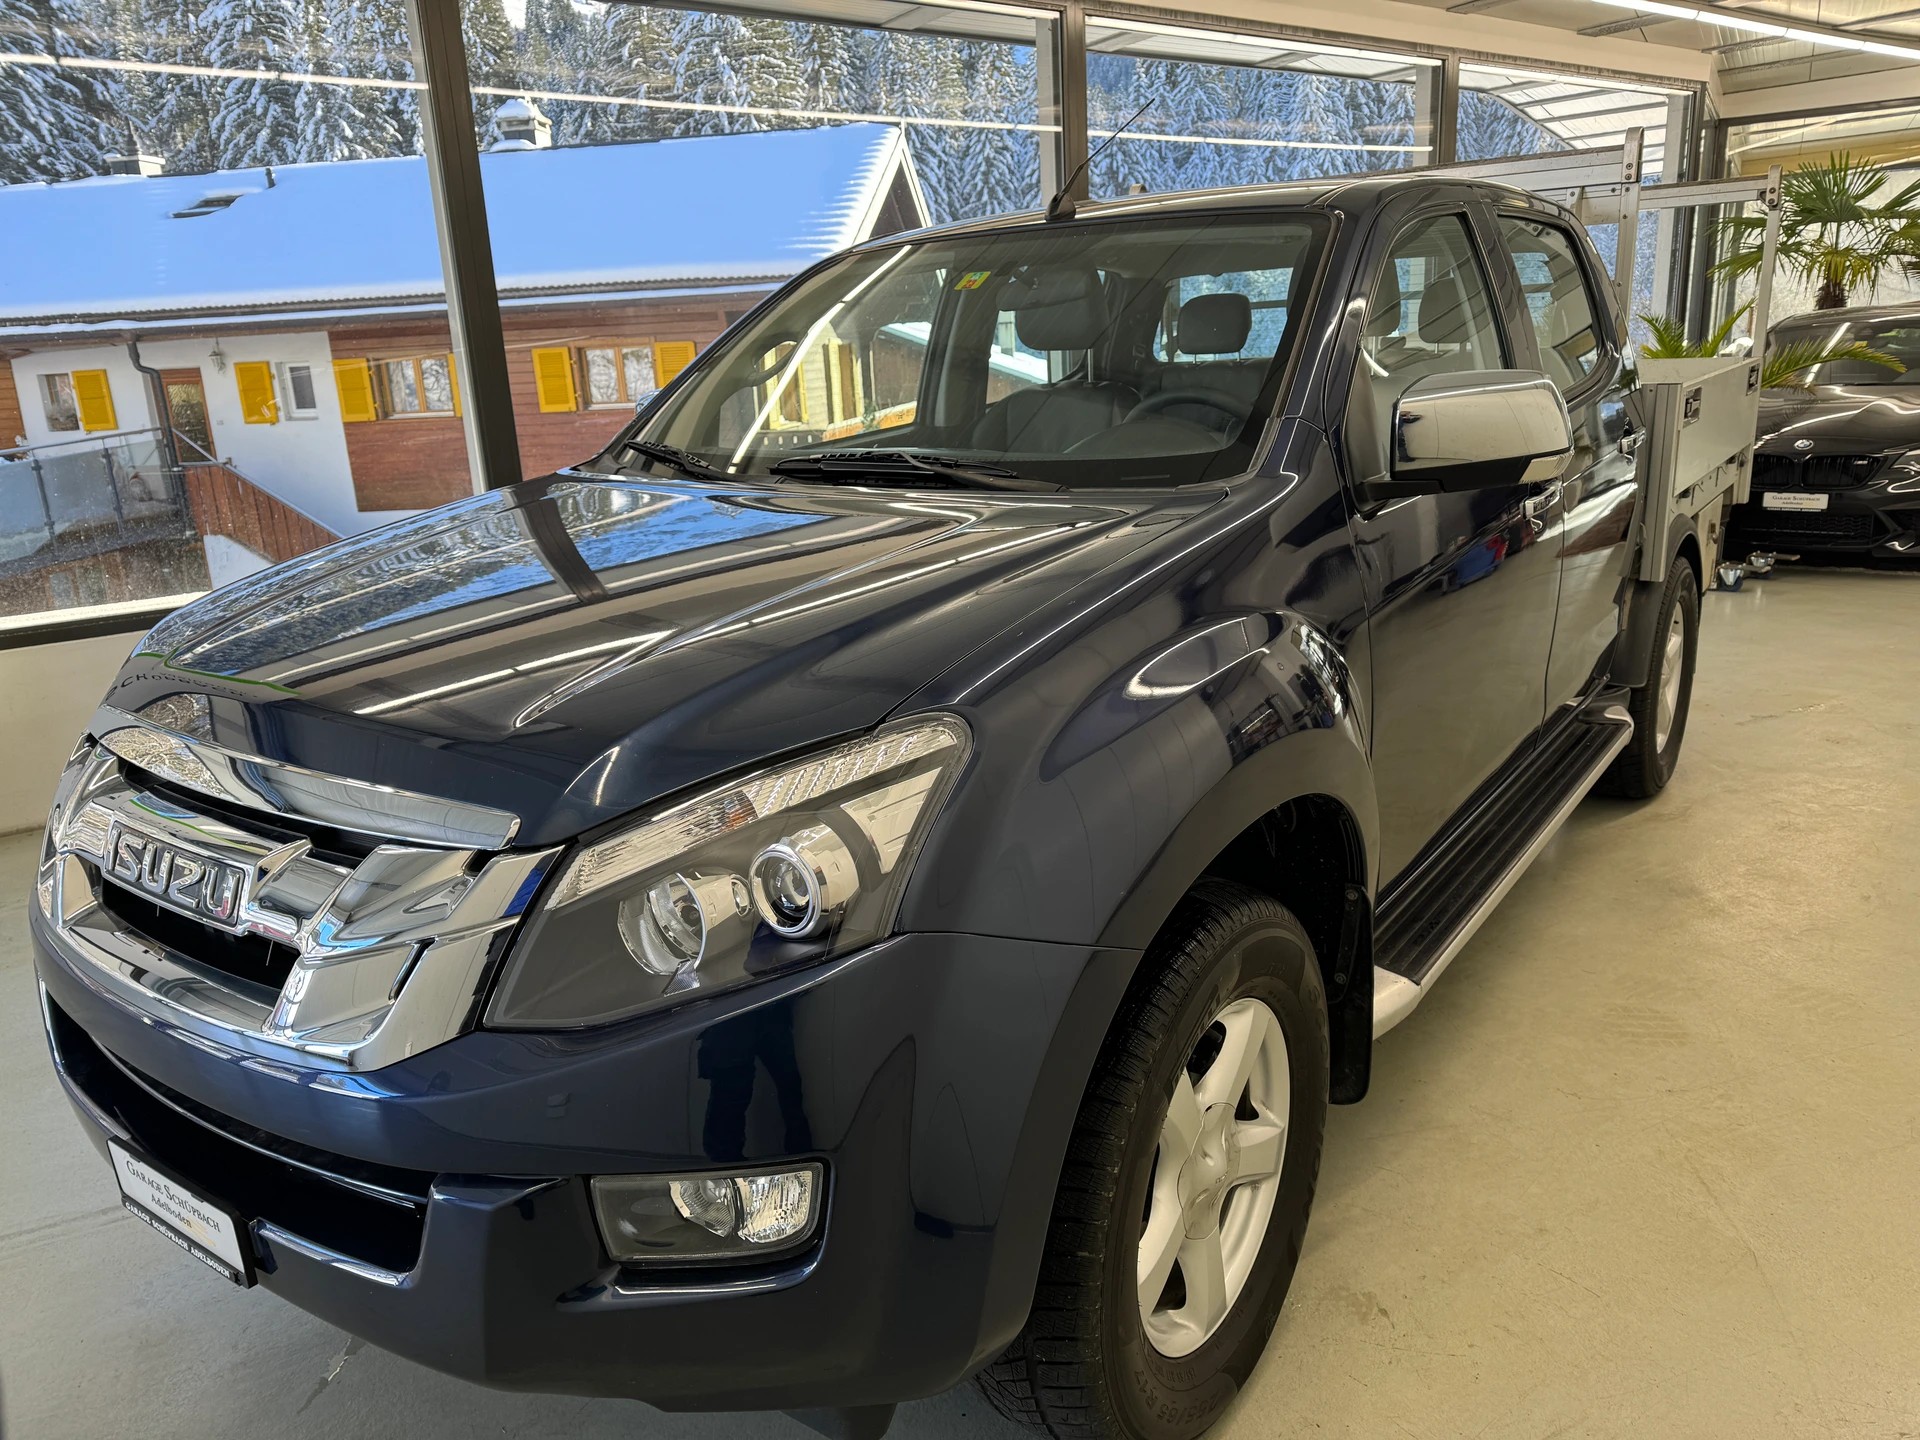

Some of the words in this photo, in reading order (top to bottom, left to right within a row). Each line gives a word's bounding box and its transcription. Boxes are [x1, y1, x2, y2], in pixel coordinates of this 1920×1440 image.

[104, 828, 240, 920] ISUZU
[126, 1160, 163, 1195] GARAGE
[163, 1184, 221, 1233] SCHÜPBACH
[151, 1193, 193, 1229] Adelboden
